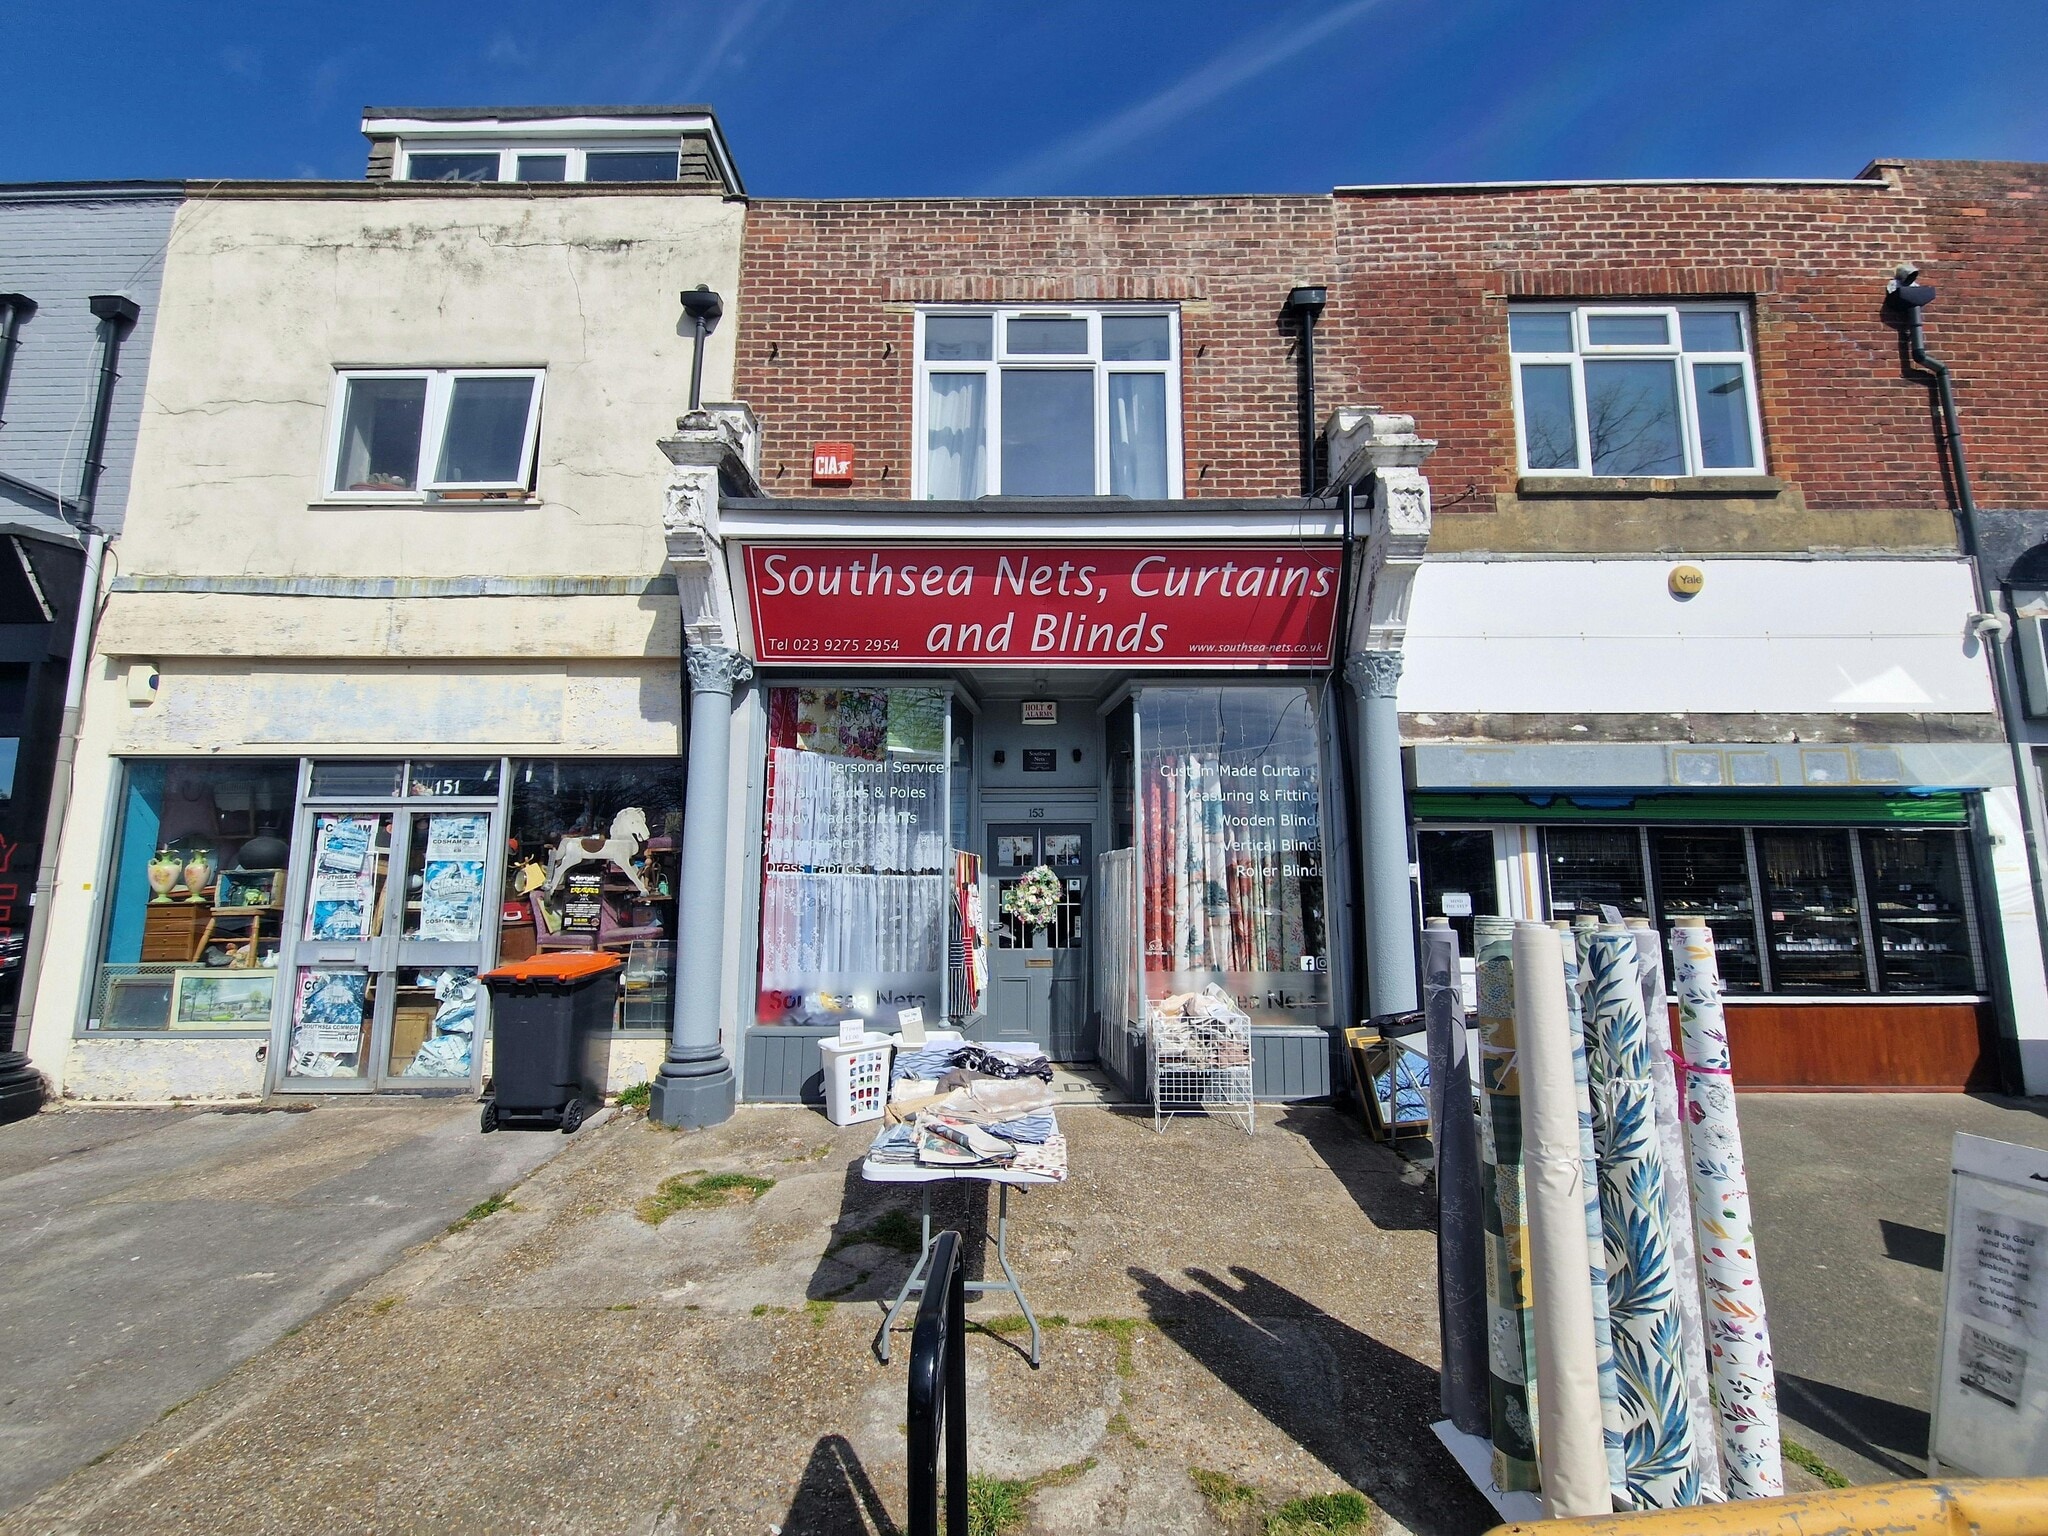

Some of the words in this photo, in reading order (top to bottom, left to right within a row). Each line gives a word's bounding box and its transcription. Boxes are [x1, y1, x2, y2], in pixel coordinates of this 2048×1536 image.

[815, 456, 838, 475] CIA
[762, 553, 974, 597] Southsea
[993, 555, 1108, 604] Nets,
[1130, 555, 1335, 598] Curtains
[1680, 574, 1702, 585] Yale
[926, 611, 1015, 653] and
[1030, 611, 1168, 653] Blinds
[768, 638, 788, 651] Tel
[793, 638, 819, 651] 023
[824, 638, 860, 651] 9275
[864, 639, 899, 651] 2954
[1189, 641, 1322, 653] www.southsea-nets.co.uk
[829, 761, 887, 773] Personal
[892, 761, 944, 773] Service
[1160, 765, 1214, 777] Custm
[1220, 765, 1257, 777] Made
[435, 780, 461, 795] 151
[874, 787, 885, 798] &
[889, 786, 926, 798] Poles
[1184, 789, 1254, 804] Measuring
[1259, 790, 1270, 801] &
[1029, 808, 1044, 818] 153
[1220, 814, 1274, 827] Wooden
[1223, 839, 1276, 852] Vertical
[766, 862, 805, 874] Dress
[876, 990, 926, 1009] Nets
[1977, 1224, 1992, 1235] We
[1994, 1229, 2010, 1240] Buy
[2013, 1234, 2036, 1247] Gold
